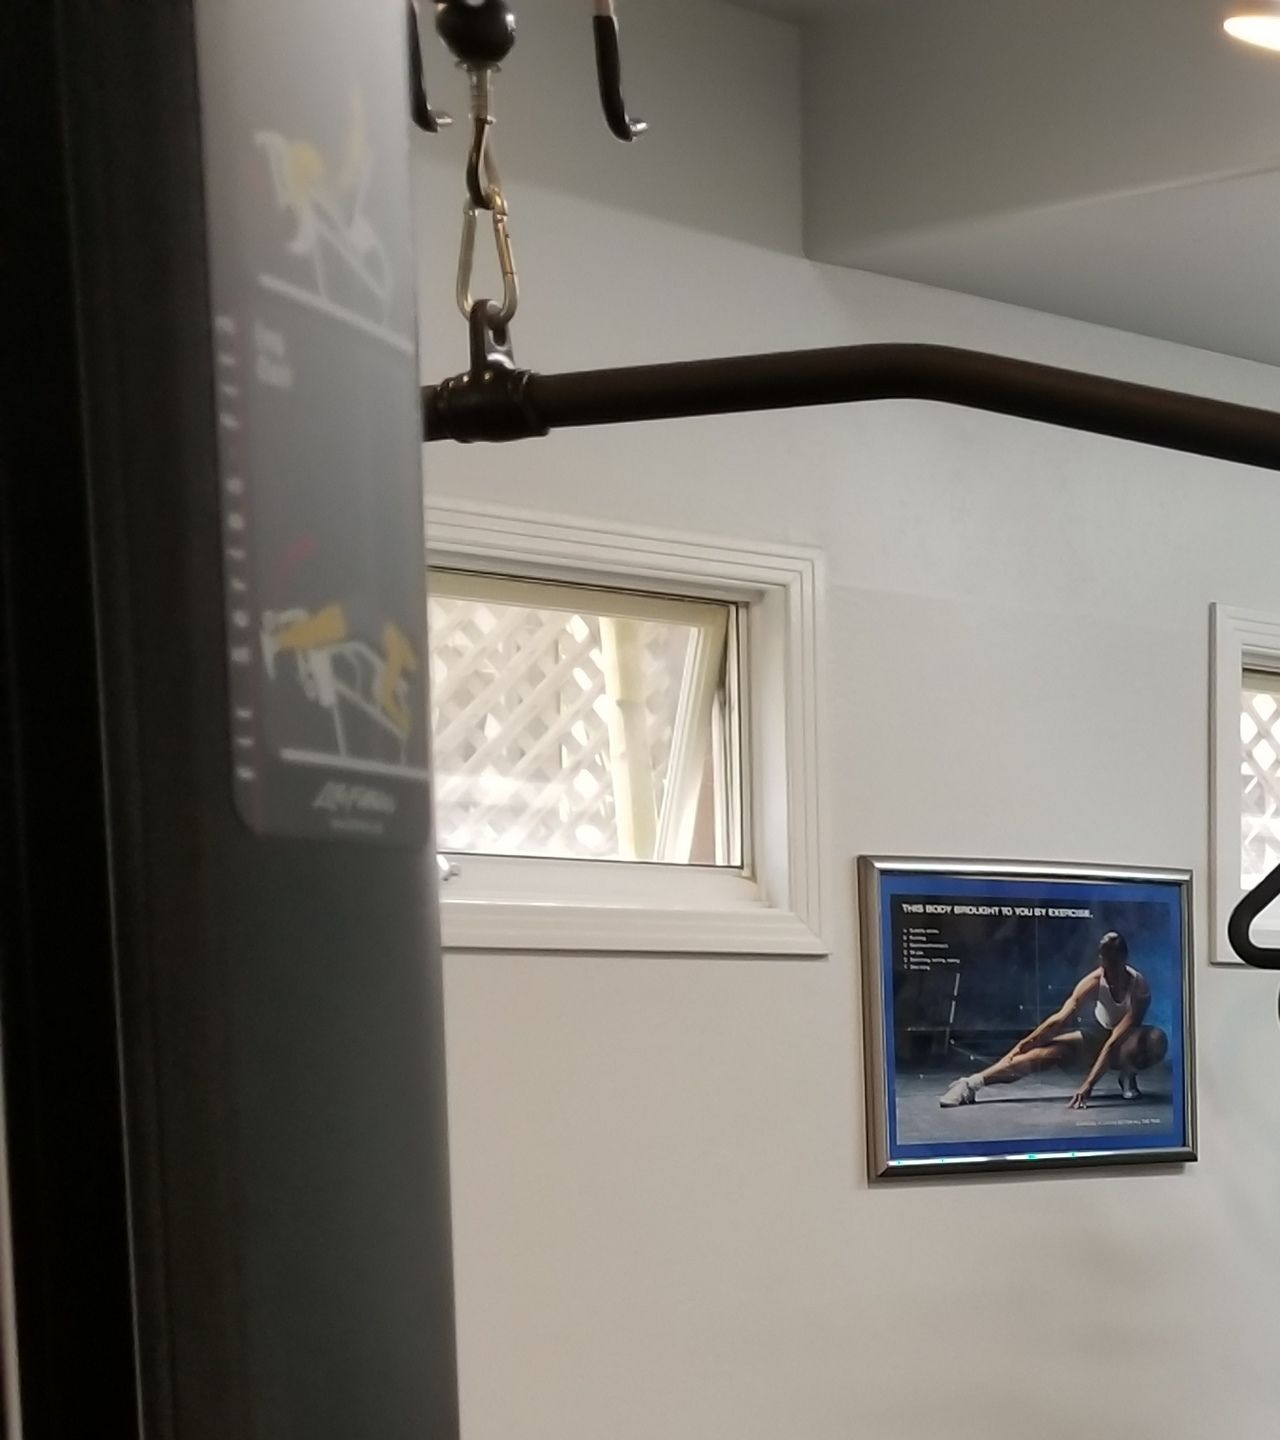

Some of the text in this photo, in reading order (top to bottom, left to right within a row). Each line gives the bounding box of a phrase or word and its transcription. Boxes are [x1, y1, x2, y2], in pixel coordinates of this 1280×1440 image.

[902, 903, 924, 913] THIS
[925, 904, 952, 914] BODY
[953, 905, 999, 916] BROUGHT
[1001, 906, 1013, 916] TO
[1014, 907, 1033, 916] YOU
[1034, 907, 1047, 917] BY
